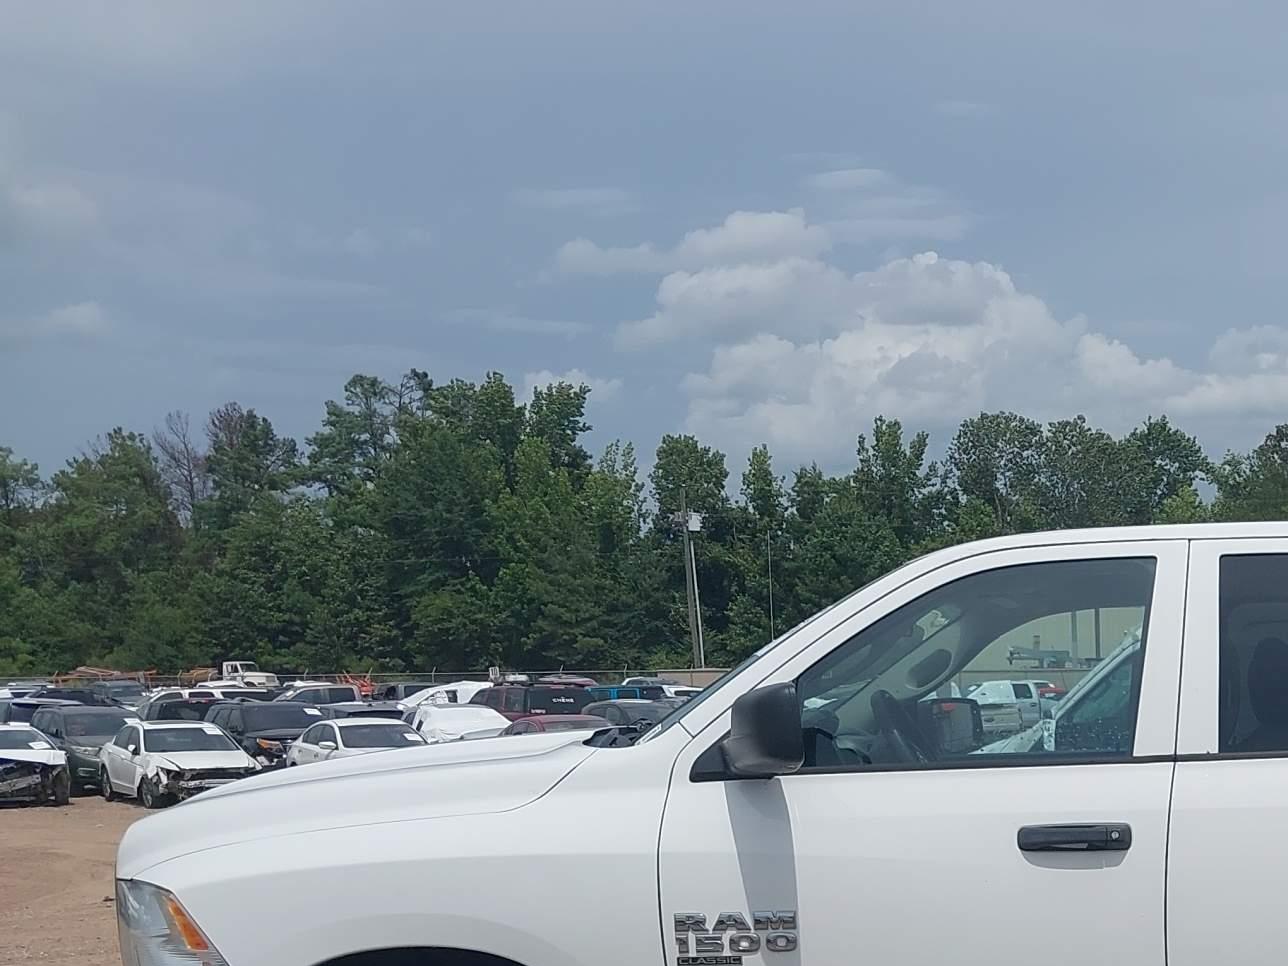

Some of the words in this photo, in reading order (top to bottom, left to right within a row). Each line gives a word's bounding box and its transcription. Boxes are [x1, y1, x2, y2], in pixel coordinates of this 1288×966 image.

[674, 911, 797, 932] RAM
[675, 932, 797, 953] 1500
[678, 957, 741, 966] CLASSIC
